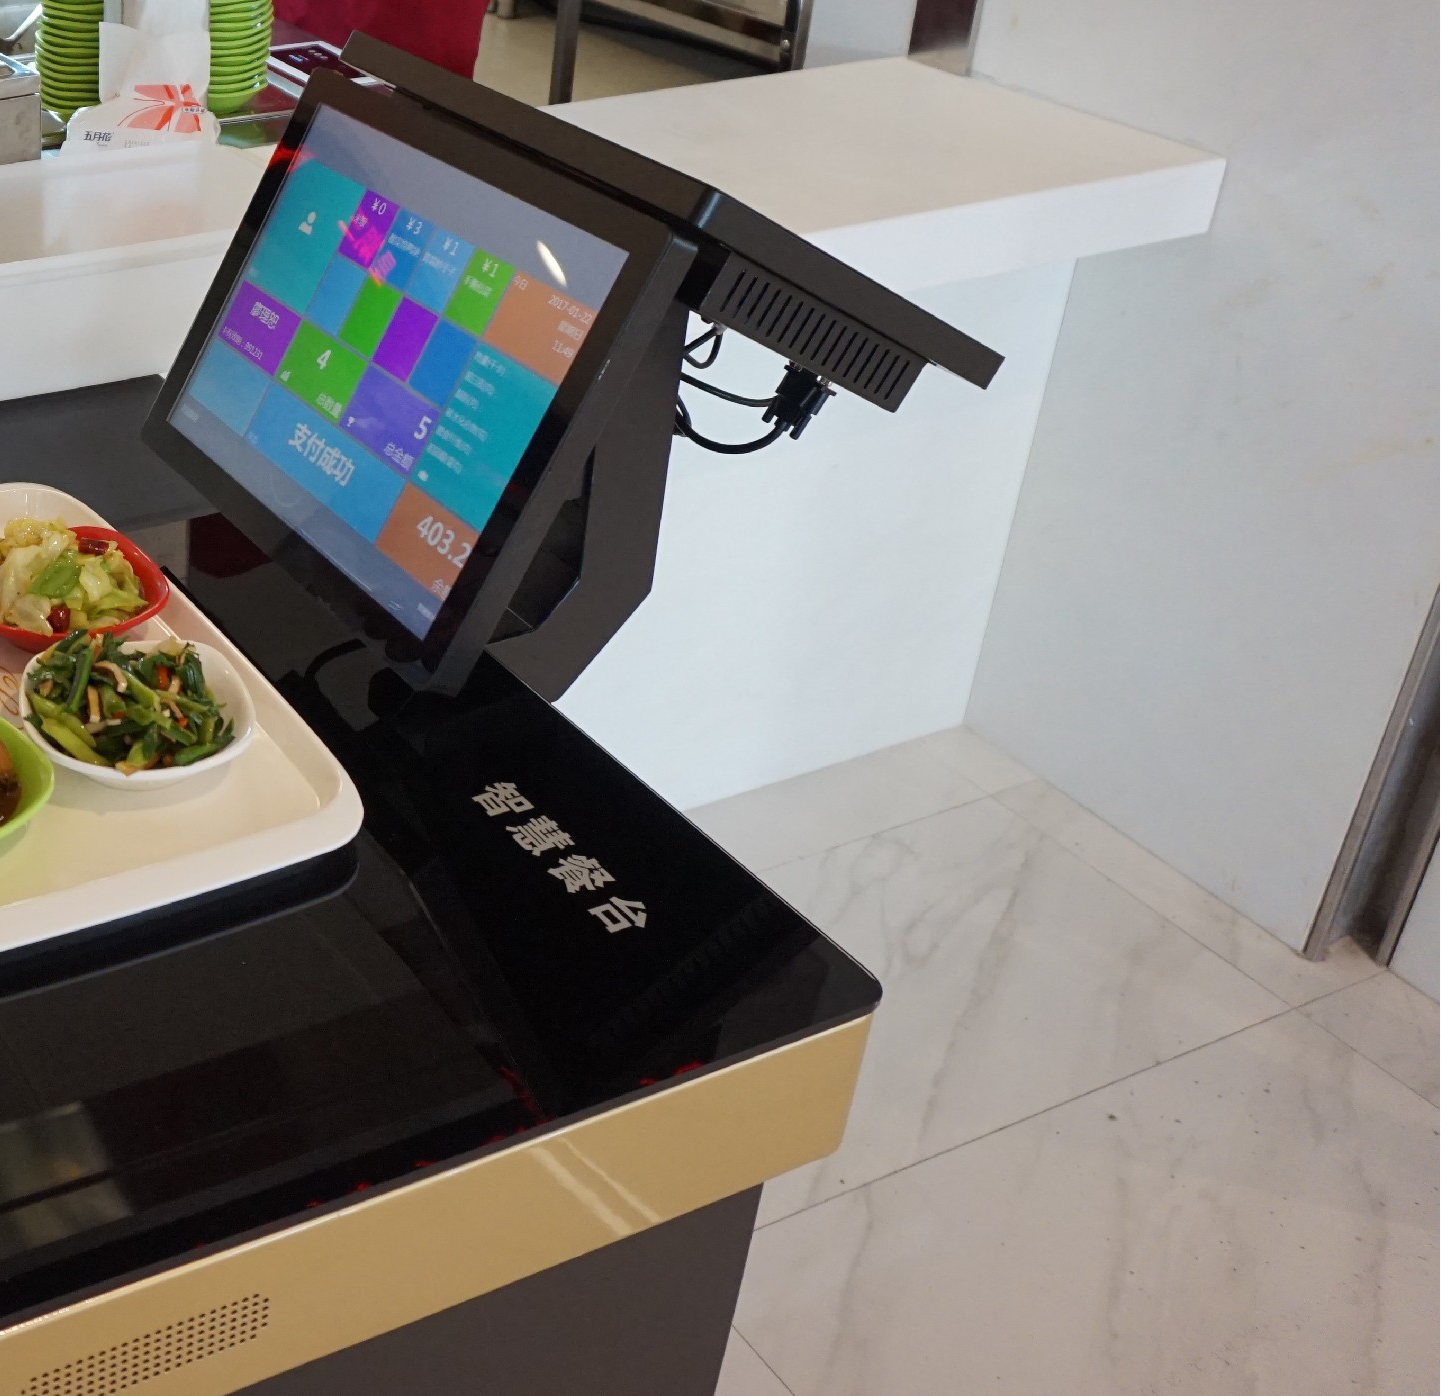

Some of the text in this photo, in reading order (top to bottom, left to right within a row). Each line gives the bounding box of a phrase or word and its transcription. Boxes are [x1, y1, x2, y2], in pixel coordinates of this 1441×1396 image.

[83, 131, 113, 142] 五月花
[316, 349, 332, 370] 4
[413, 415, 432, 440] 5
[288, 422, 356, 487] 支付成功
[416, 515, 473, 568] 403.2
[471, 782, 647, 934] 智慧餐台
